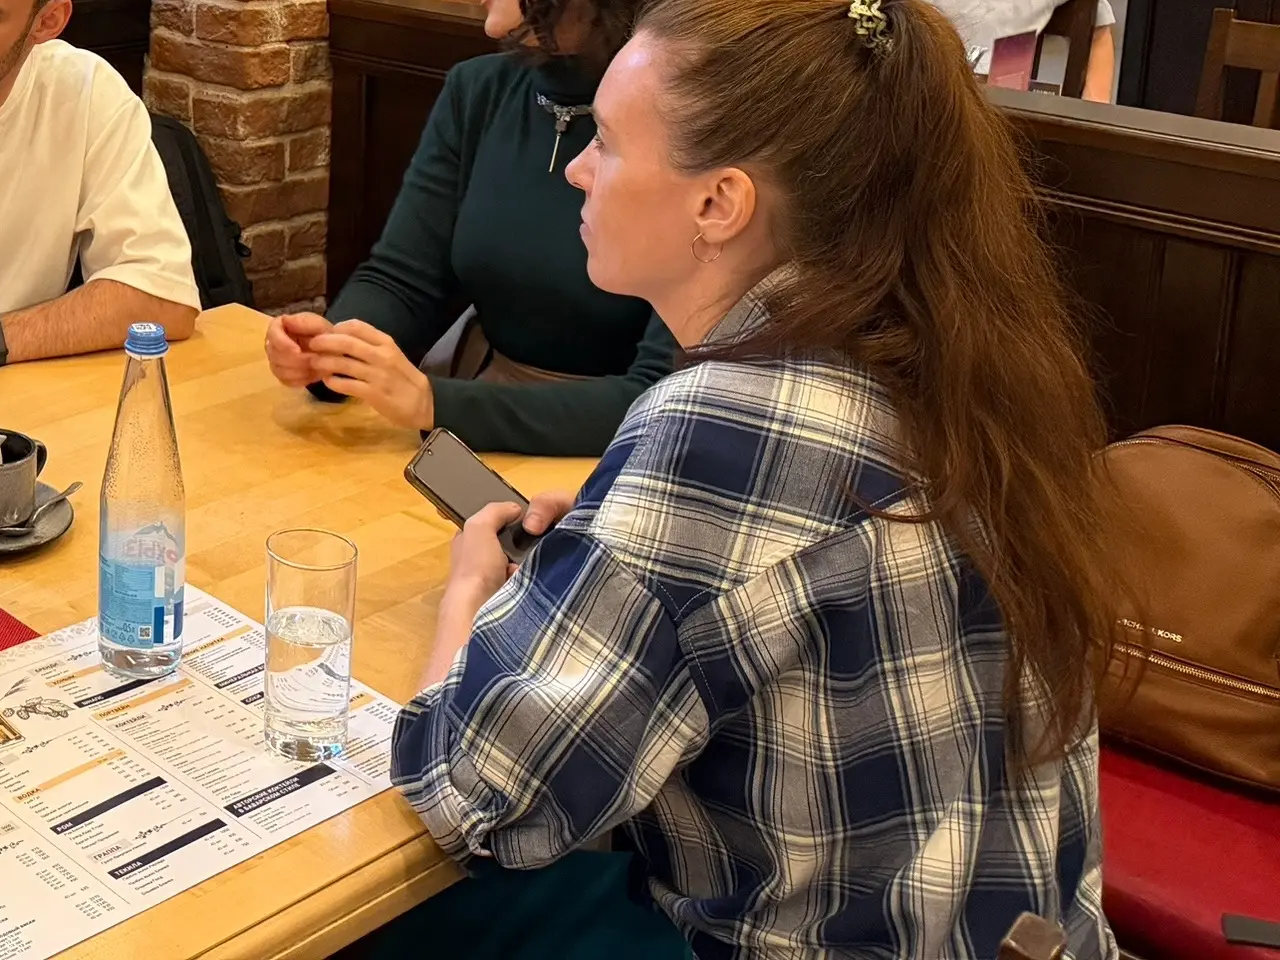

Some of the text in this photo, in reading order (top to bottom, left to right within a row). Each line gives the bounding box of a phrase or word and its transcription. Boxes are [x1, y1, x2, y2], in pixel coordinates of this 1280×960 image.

[1157, 629, 1183, 643] KORS
[17, 787, 41, 800] ВОДКА
[56, 822, 73, 833] РОМ
[93, 845, 122, 861] ГРАППА
[115, 860, 143, 876] ТЕКИЛА
